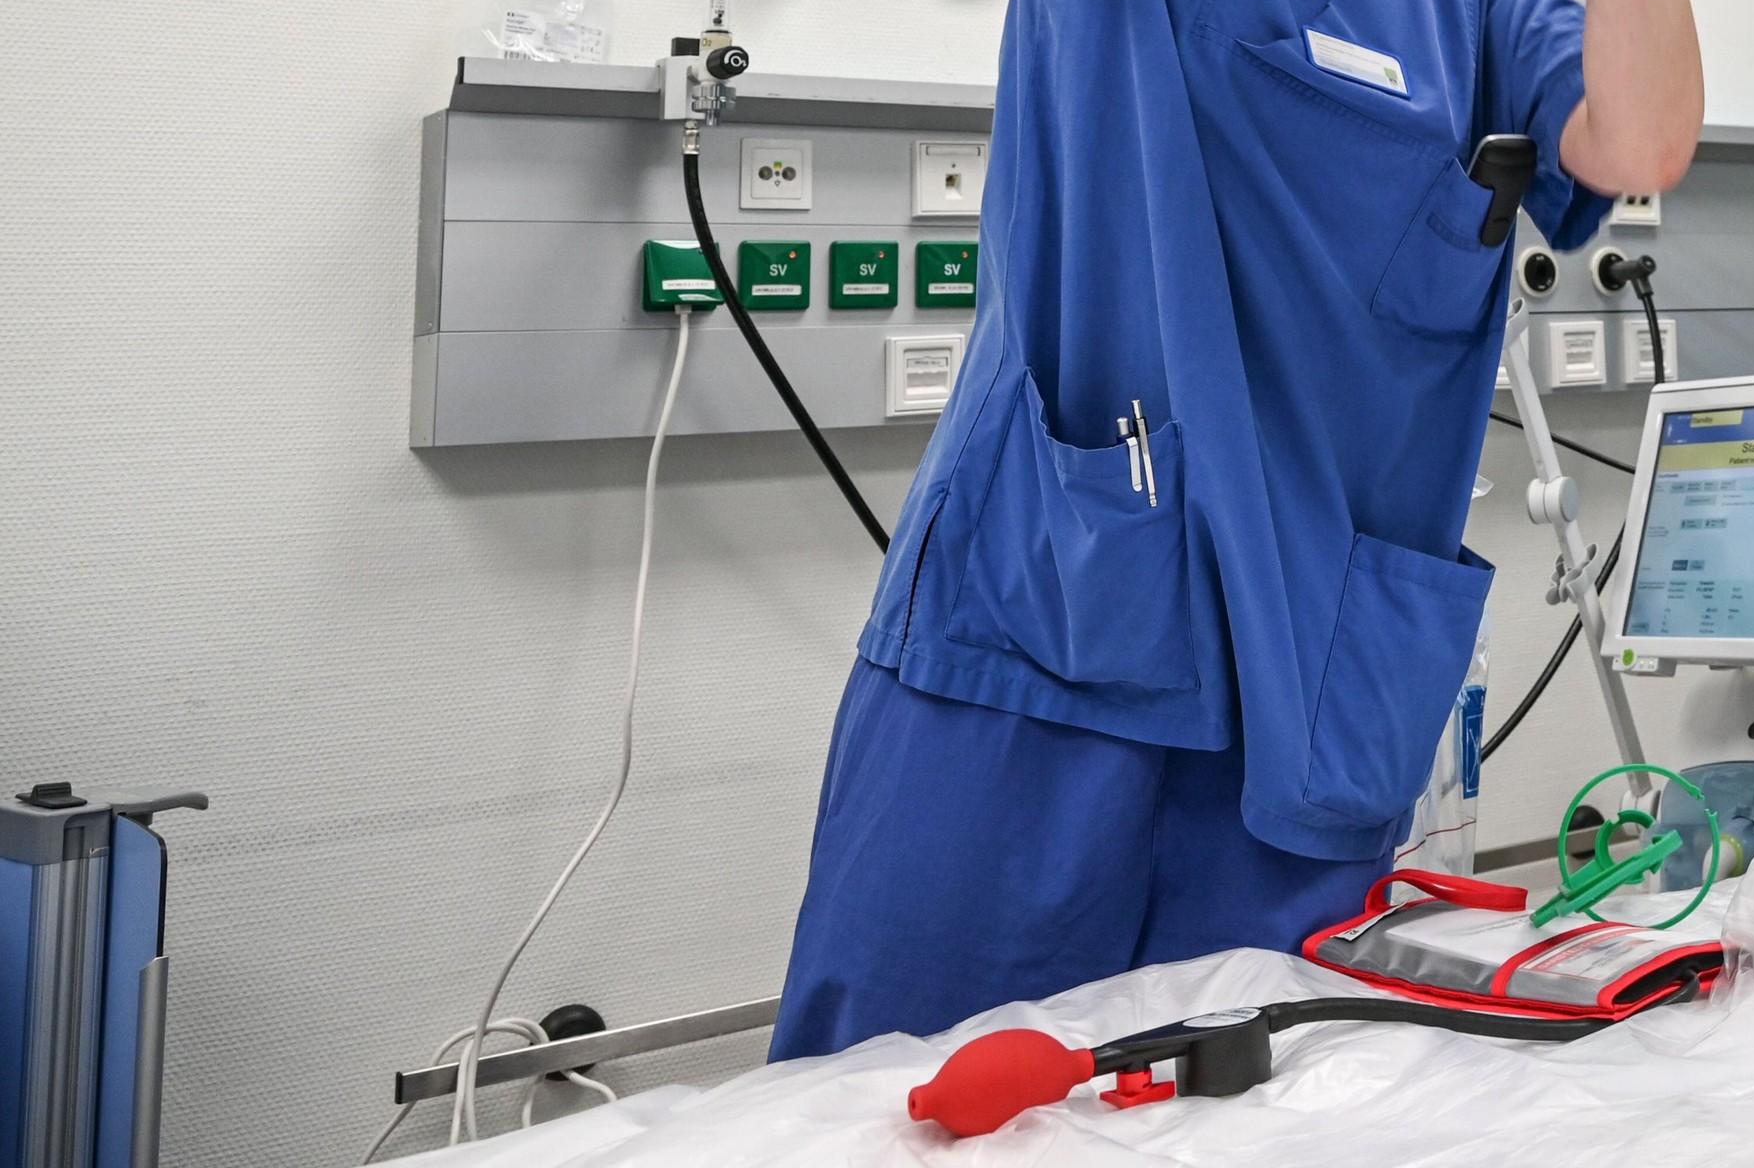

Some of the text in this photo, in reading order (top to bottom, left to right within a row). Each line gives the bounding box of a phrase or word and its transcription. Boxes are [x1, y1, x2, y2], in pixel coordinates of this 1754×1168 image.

[769, 264, 788, 276] SV
[859, 264, 877, 276] SV
[944, 264, 961, 276] SV
